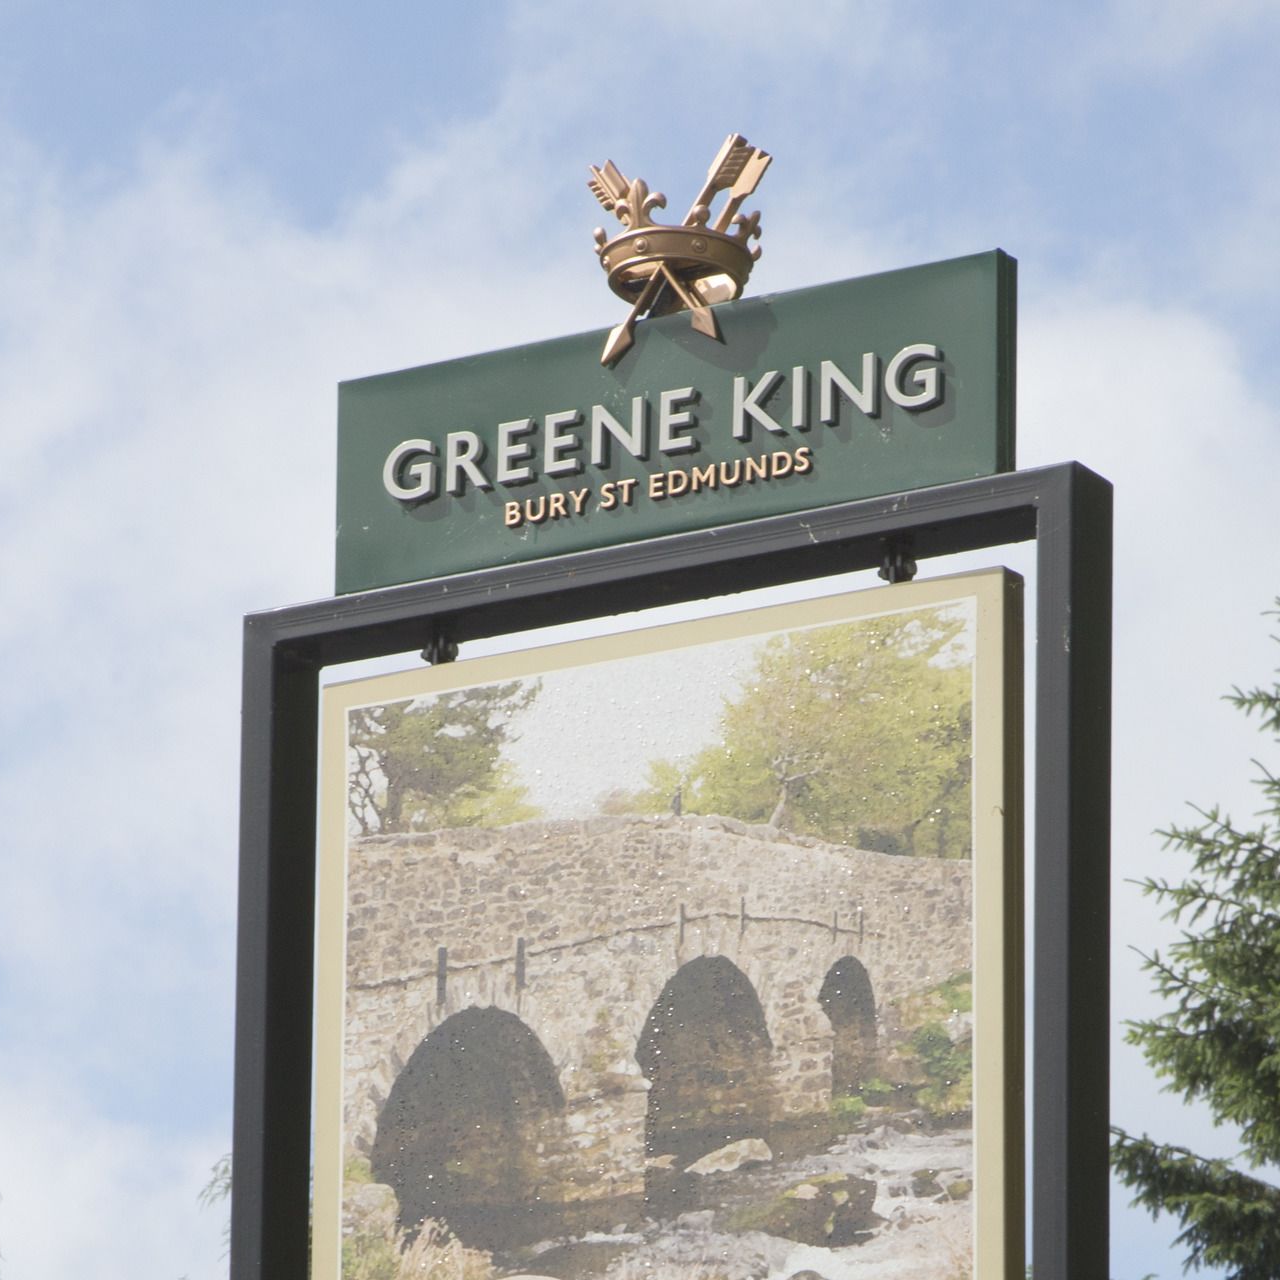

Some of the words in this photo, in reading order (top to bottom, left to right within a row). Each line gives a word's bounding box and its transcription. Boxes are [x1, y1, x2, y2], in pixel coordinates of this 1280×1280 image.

[382, 386, 698, 500] GREENE
[732, 343, 943, 439] KING
[504, 488, 588, 527] BURY
[600, 478, 637, 509] ST
[649, 447, 813, 499] EDMUNDS
